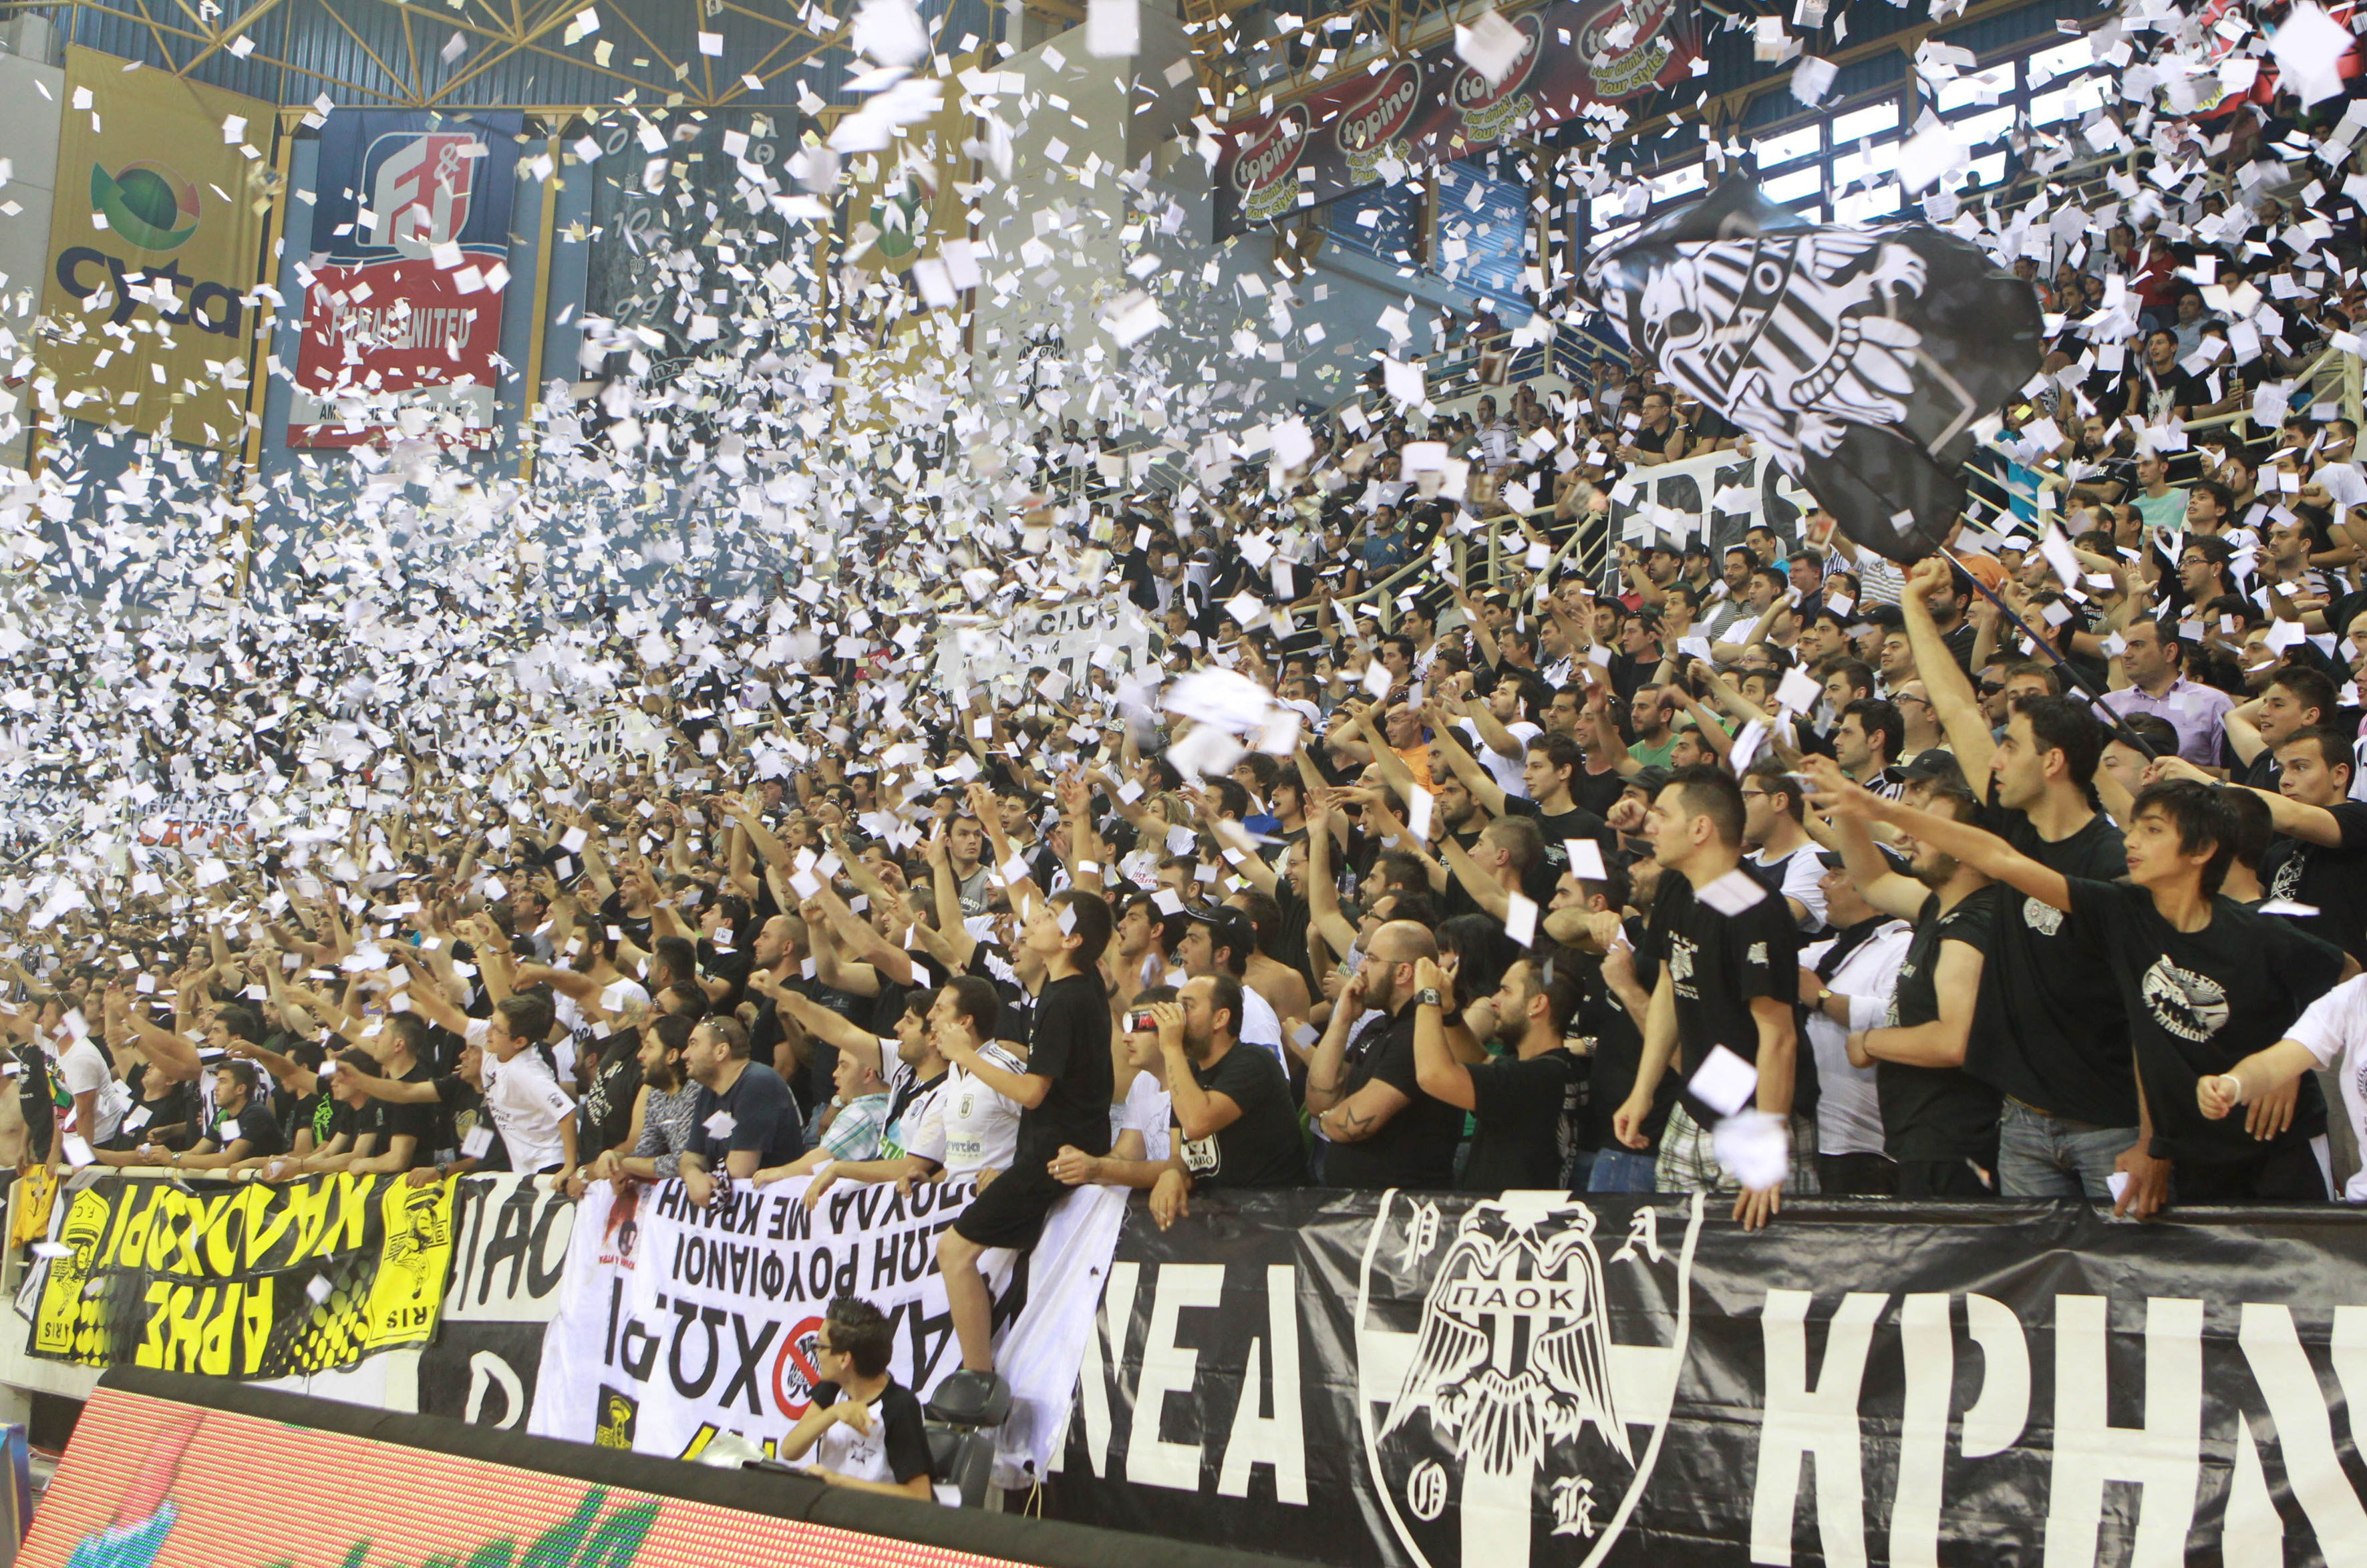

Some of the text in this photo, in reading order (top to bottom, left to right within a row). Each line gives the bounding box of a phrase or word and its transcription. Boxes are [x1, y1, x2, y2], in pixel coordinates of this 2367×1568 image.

[1597, 47, 1667, 94] Your style!
[1344, 81, 1415, 144] topino
[1469, 126, 1497, 140] Your
[1239, 122, 1303, 183] topino
[1272, 178, 1299, 214] style!
[56, 246, 244, 339] cyta
[1452, 1286, 1576, 1311] ΠΑΟΚ
